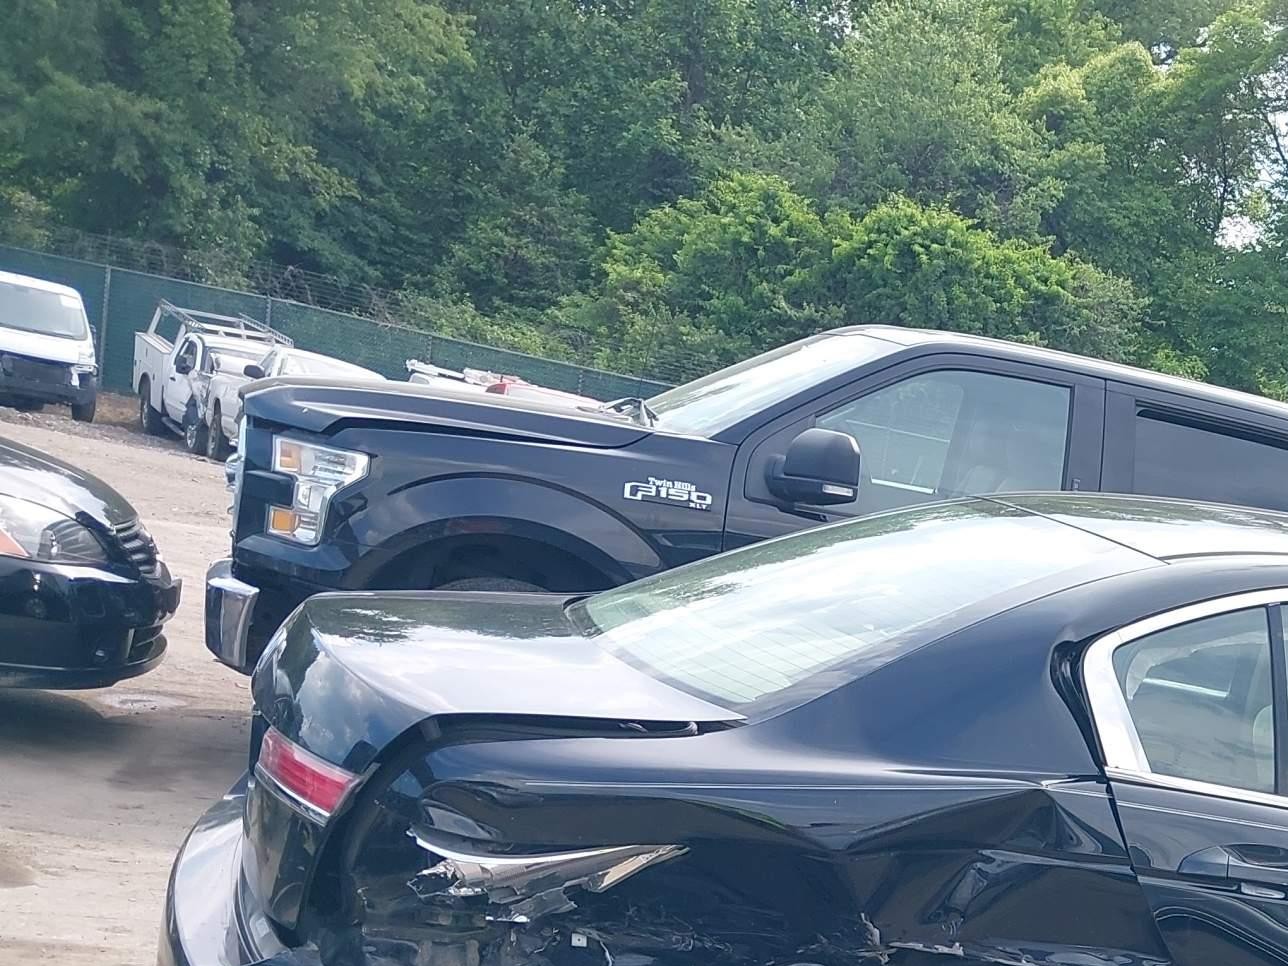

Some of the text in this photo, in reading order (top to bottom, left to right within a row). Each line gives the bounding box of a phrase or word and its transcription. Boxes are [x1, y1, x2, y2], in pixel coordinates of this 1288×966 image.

[647, 476, 673, 488] Twin
[623, 481, 713, 505] F150
[688, 502, 708, 510] XLT
